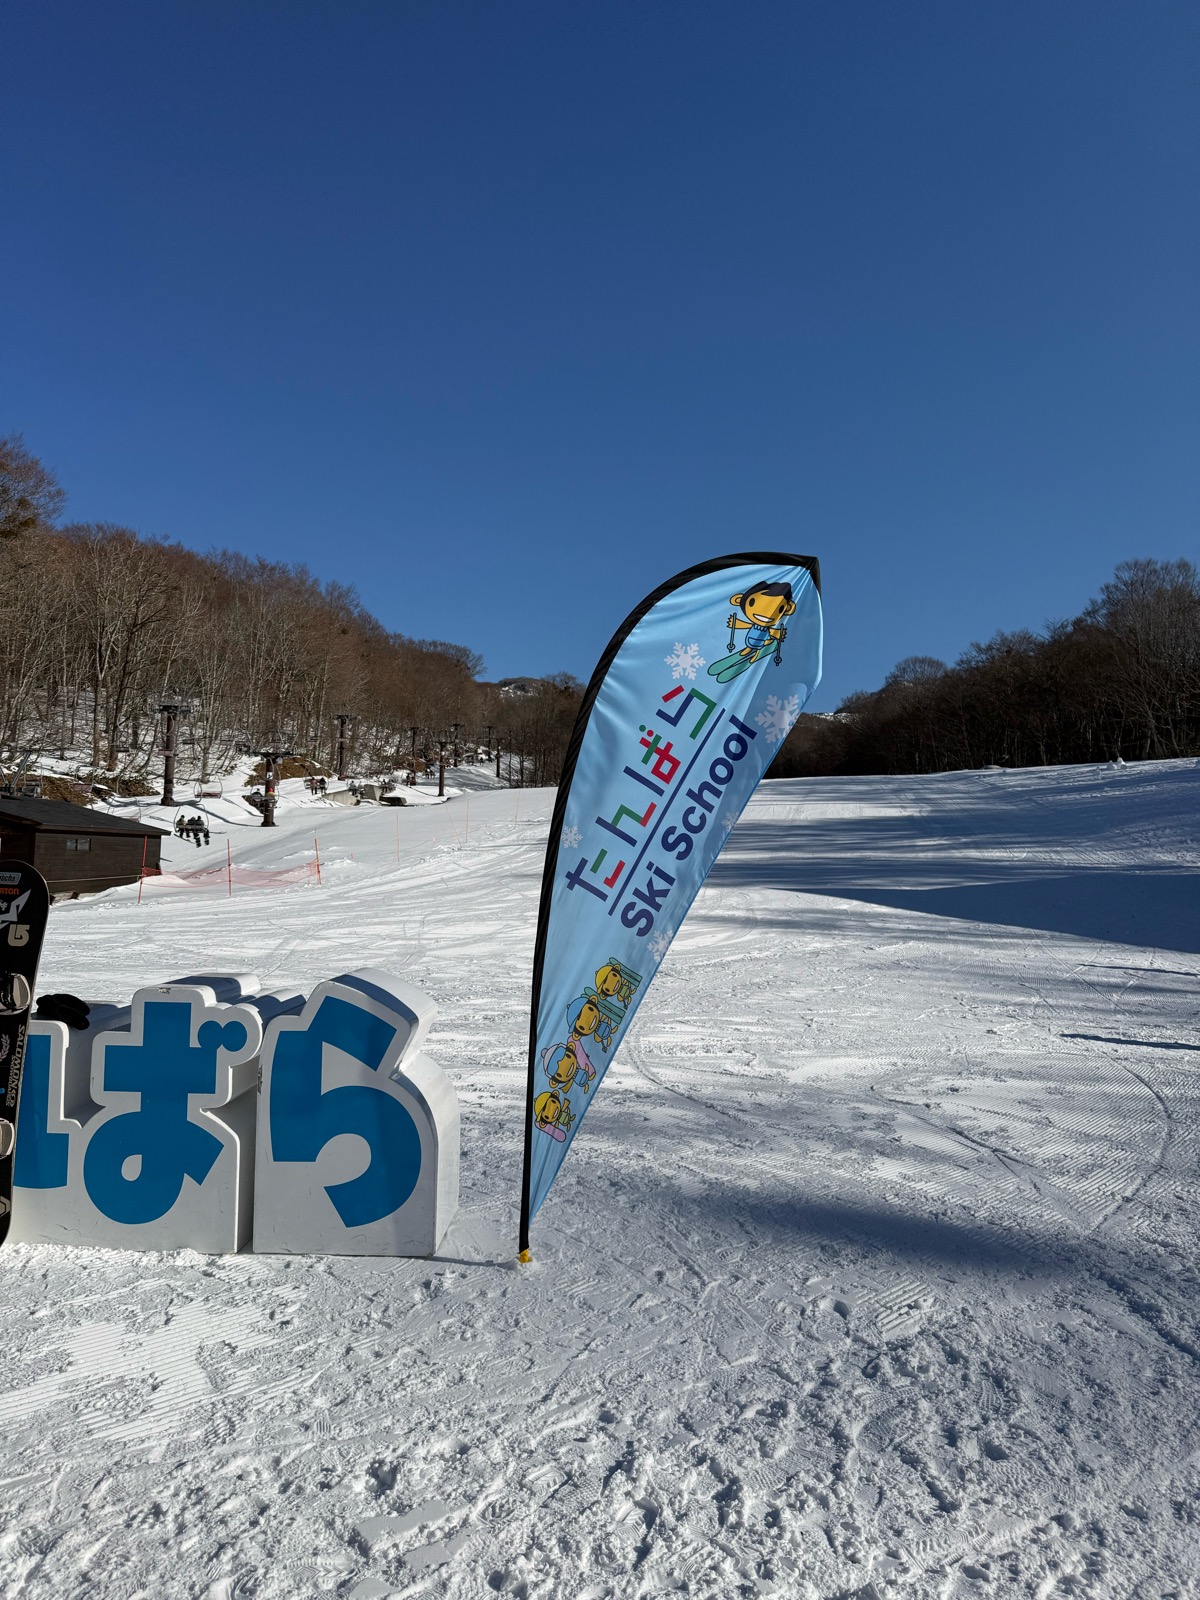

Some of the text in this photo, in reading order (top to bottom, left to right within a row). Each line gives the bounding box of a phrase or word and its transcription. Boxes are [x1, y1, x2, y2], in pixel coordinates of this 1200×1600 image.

[565, 685, 717, 902] たんばら
[620, 714, 758, 937] Ski School
[13, 1023, 25, 1089] SALOMON
